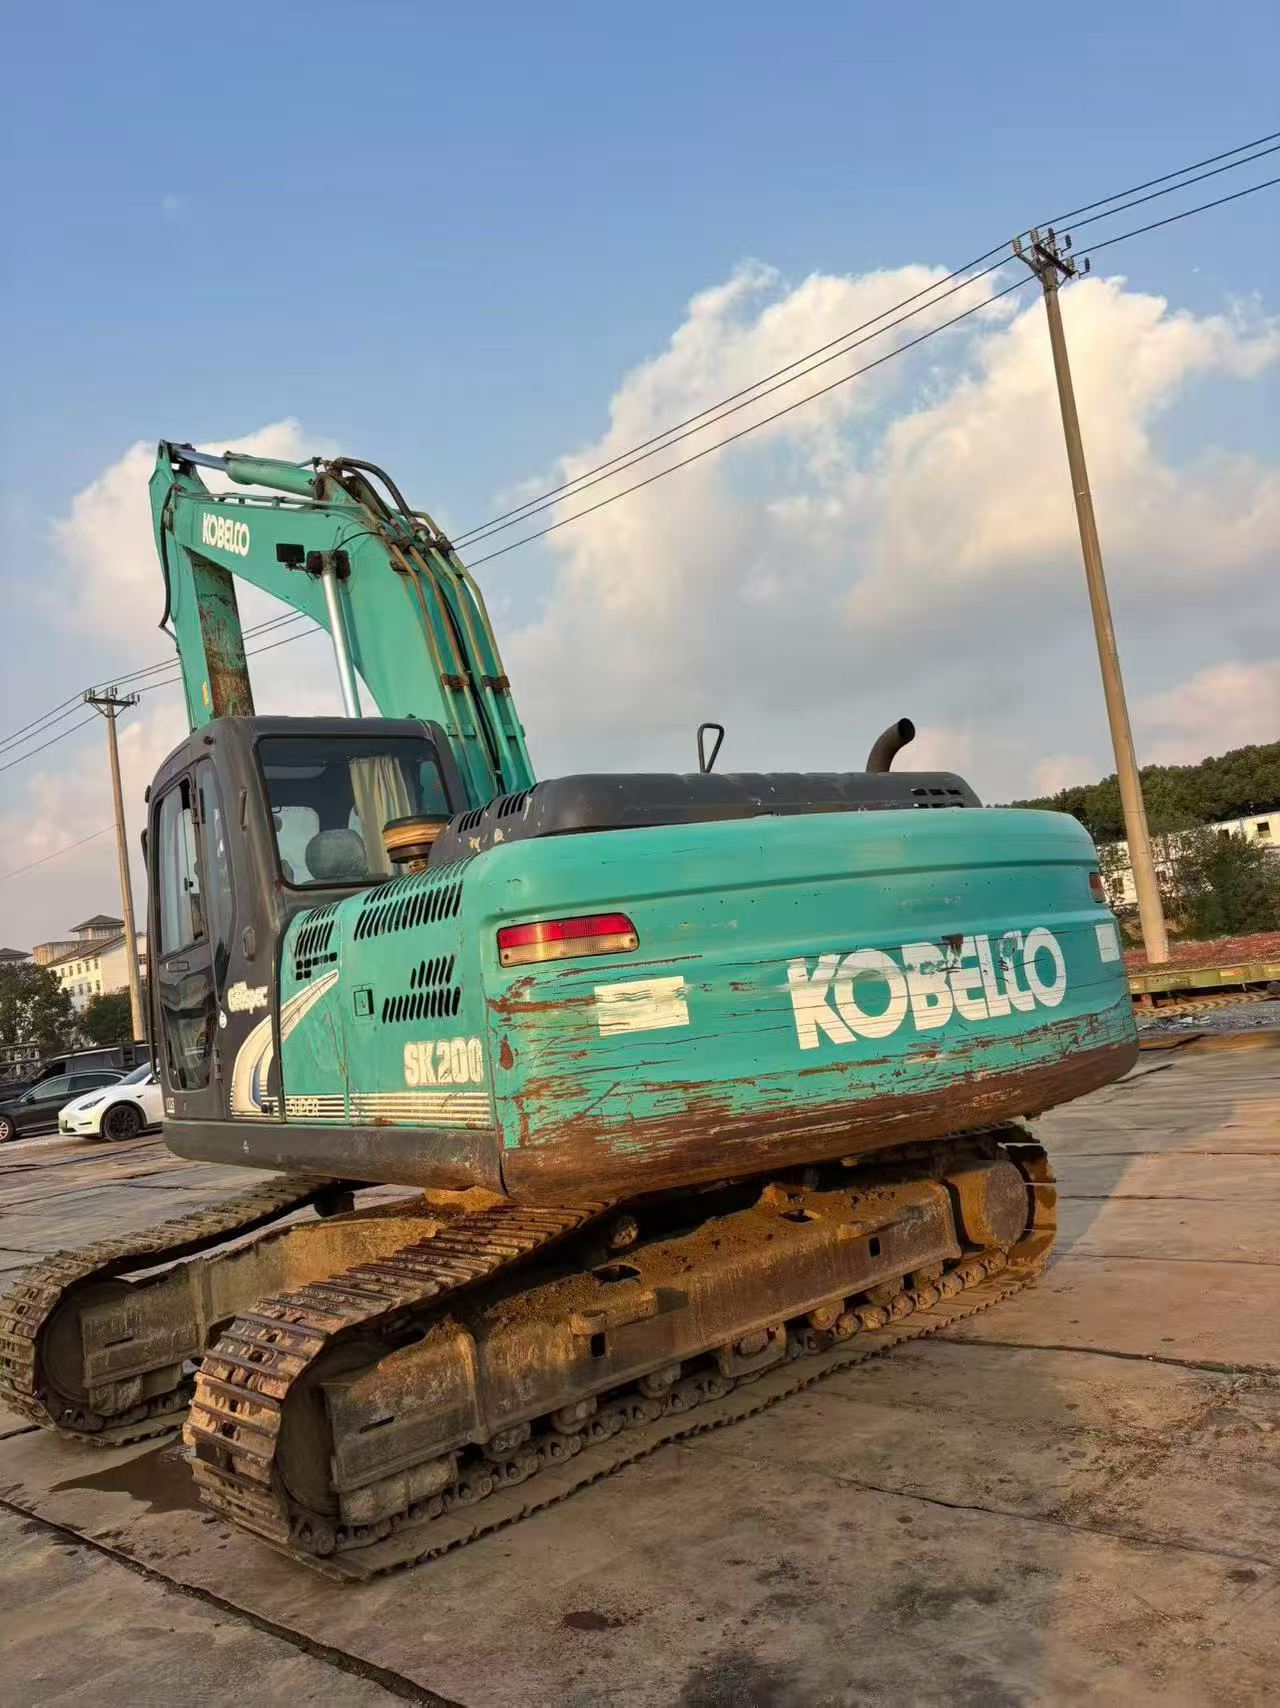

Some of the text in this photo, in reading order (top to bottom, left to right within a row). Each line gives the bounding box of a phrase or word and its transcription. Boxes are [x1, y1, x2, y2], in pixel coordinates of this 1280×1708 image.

[202, 512, 250, 557] KOBELCO
[787, 927, 1067, 1050] KOBELCO
[404, 1036, 484, 1087] SK200
